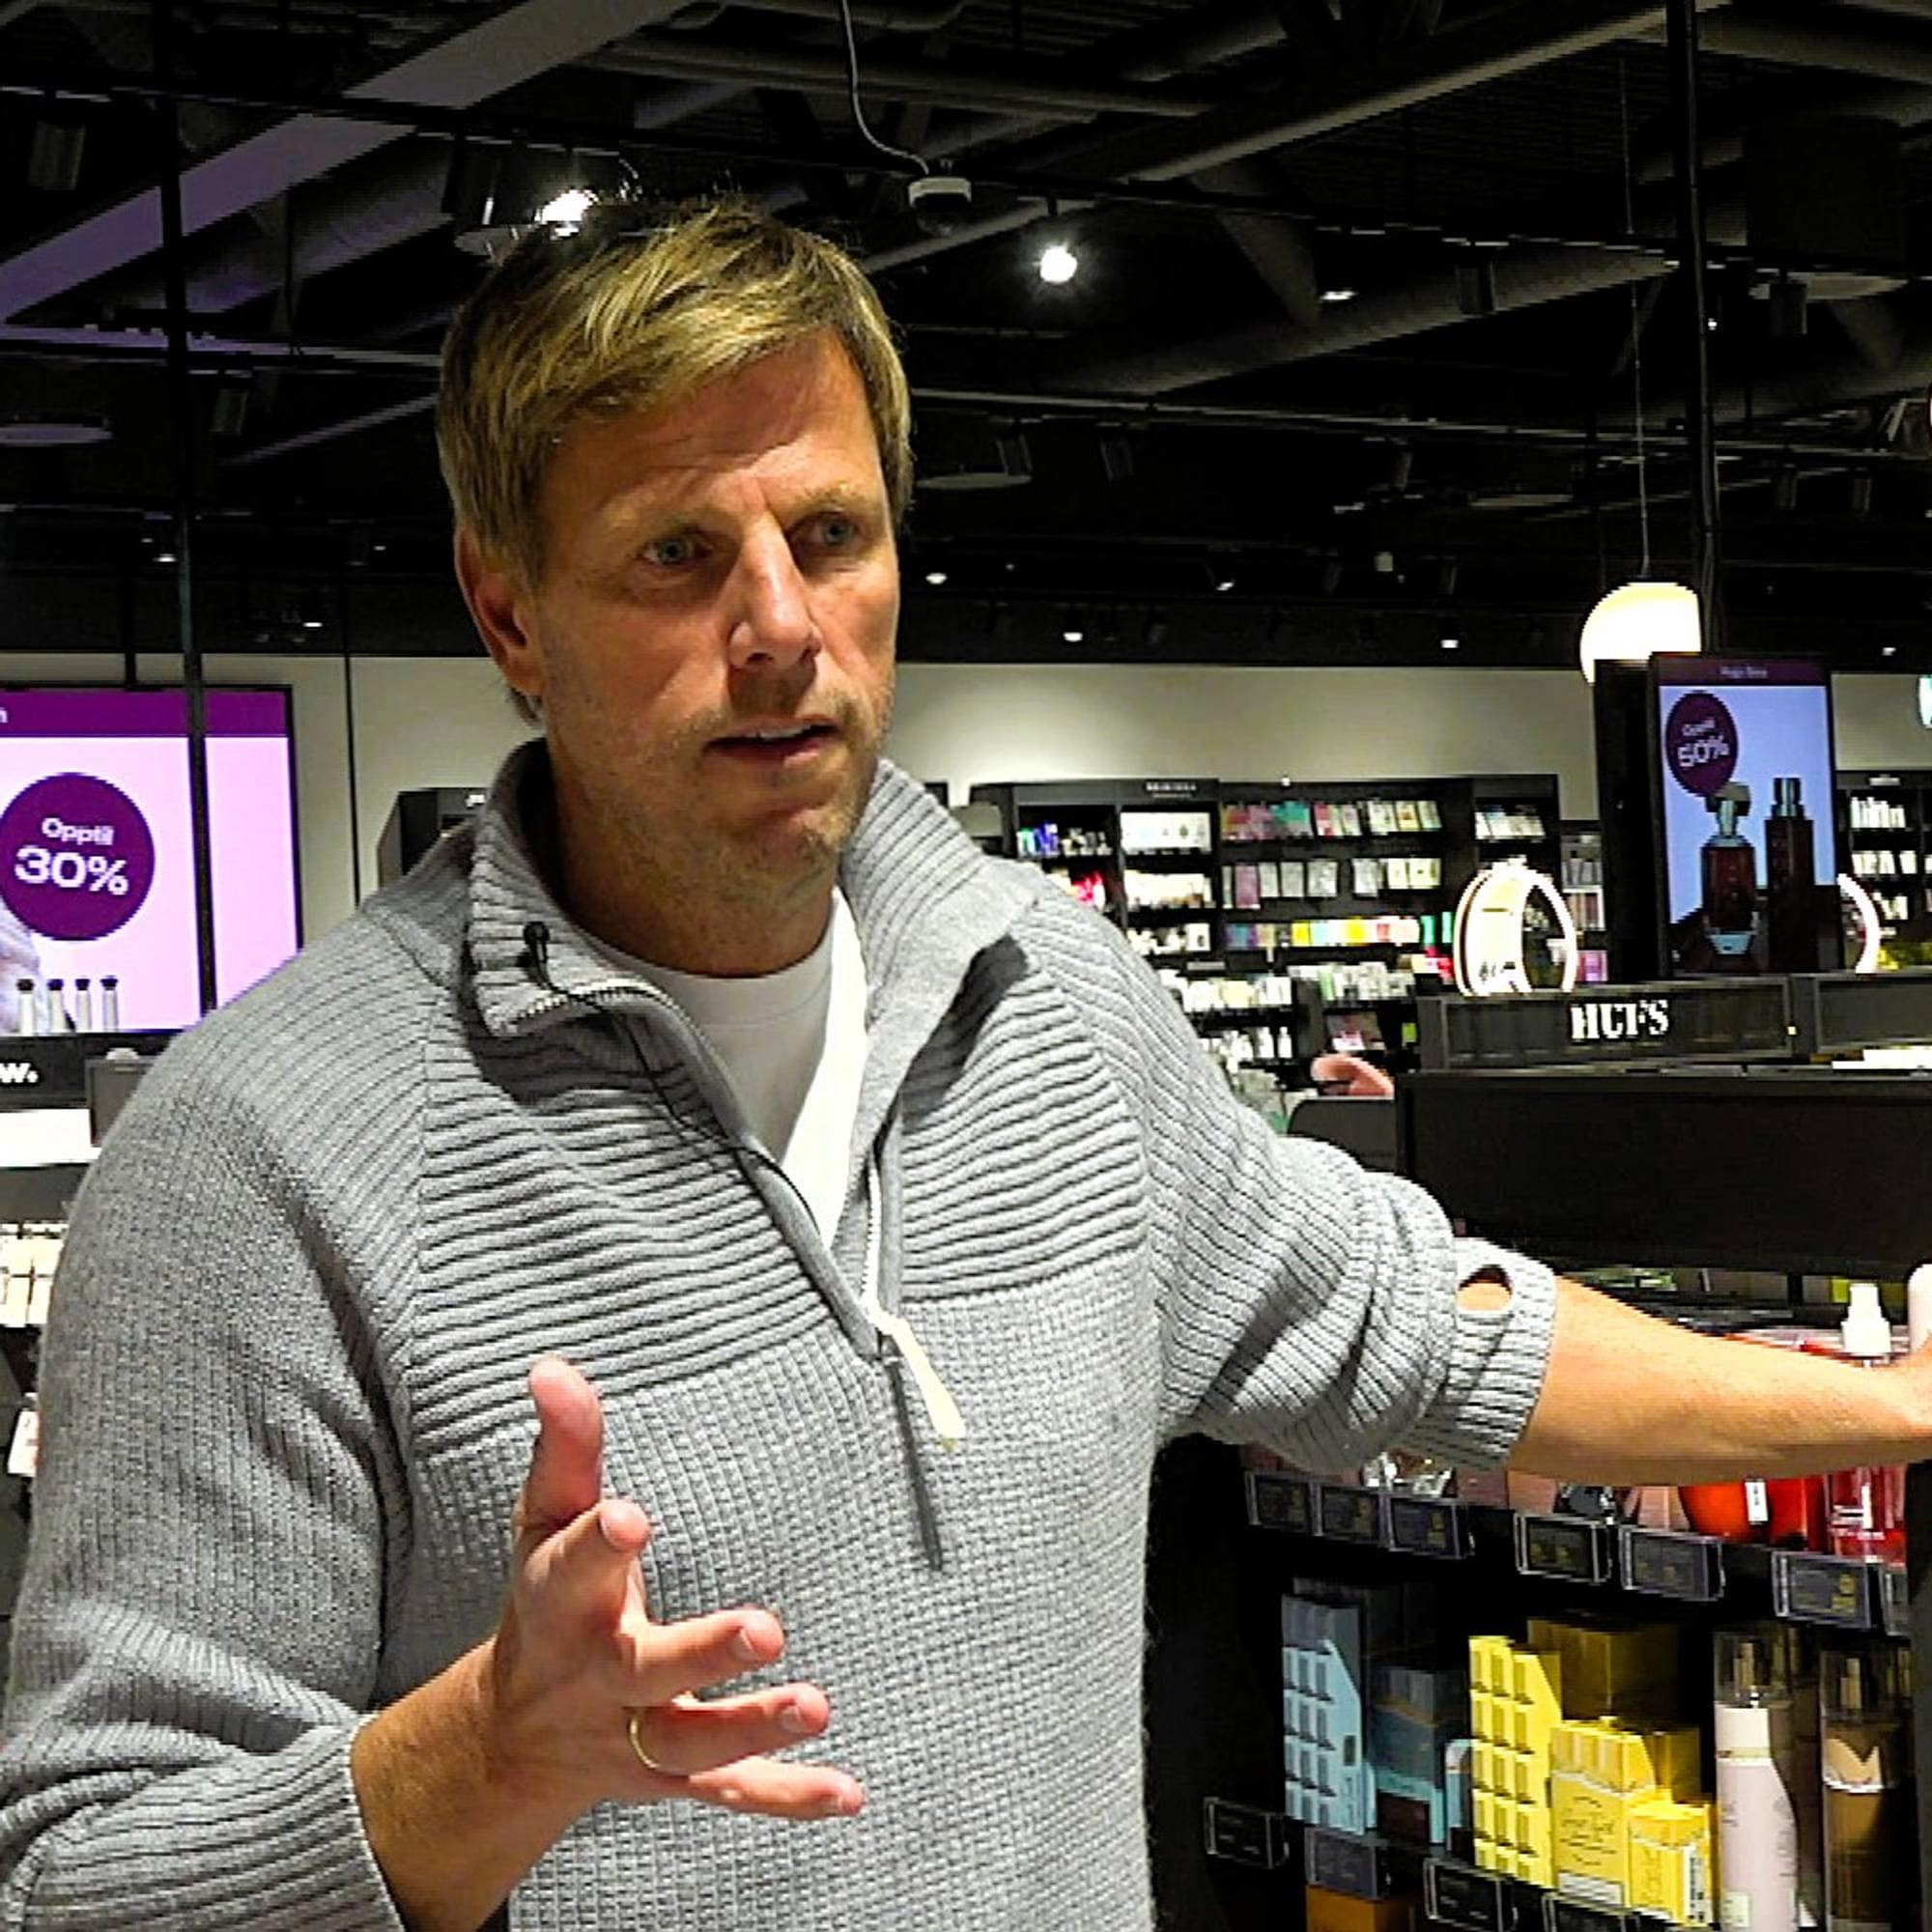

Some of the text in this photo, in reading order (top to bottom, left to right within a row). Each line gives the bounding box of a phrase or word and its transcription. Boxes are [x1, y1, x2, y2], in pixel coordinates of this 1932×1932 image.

[1677, 735, 1729, 768] 50%
[42, 817, 115, 845] Opptil
[14, 845, 128, 895] 30%
